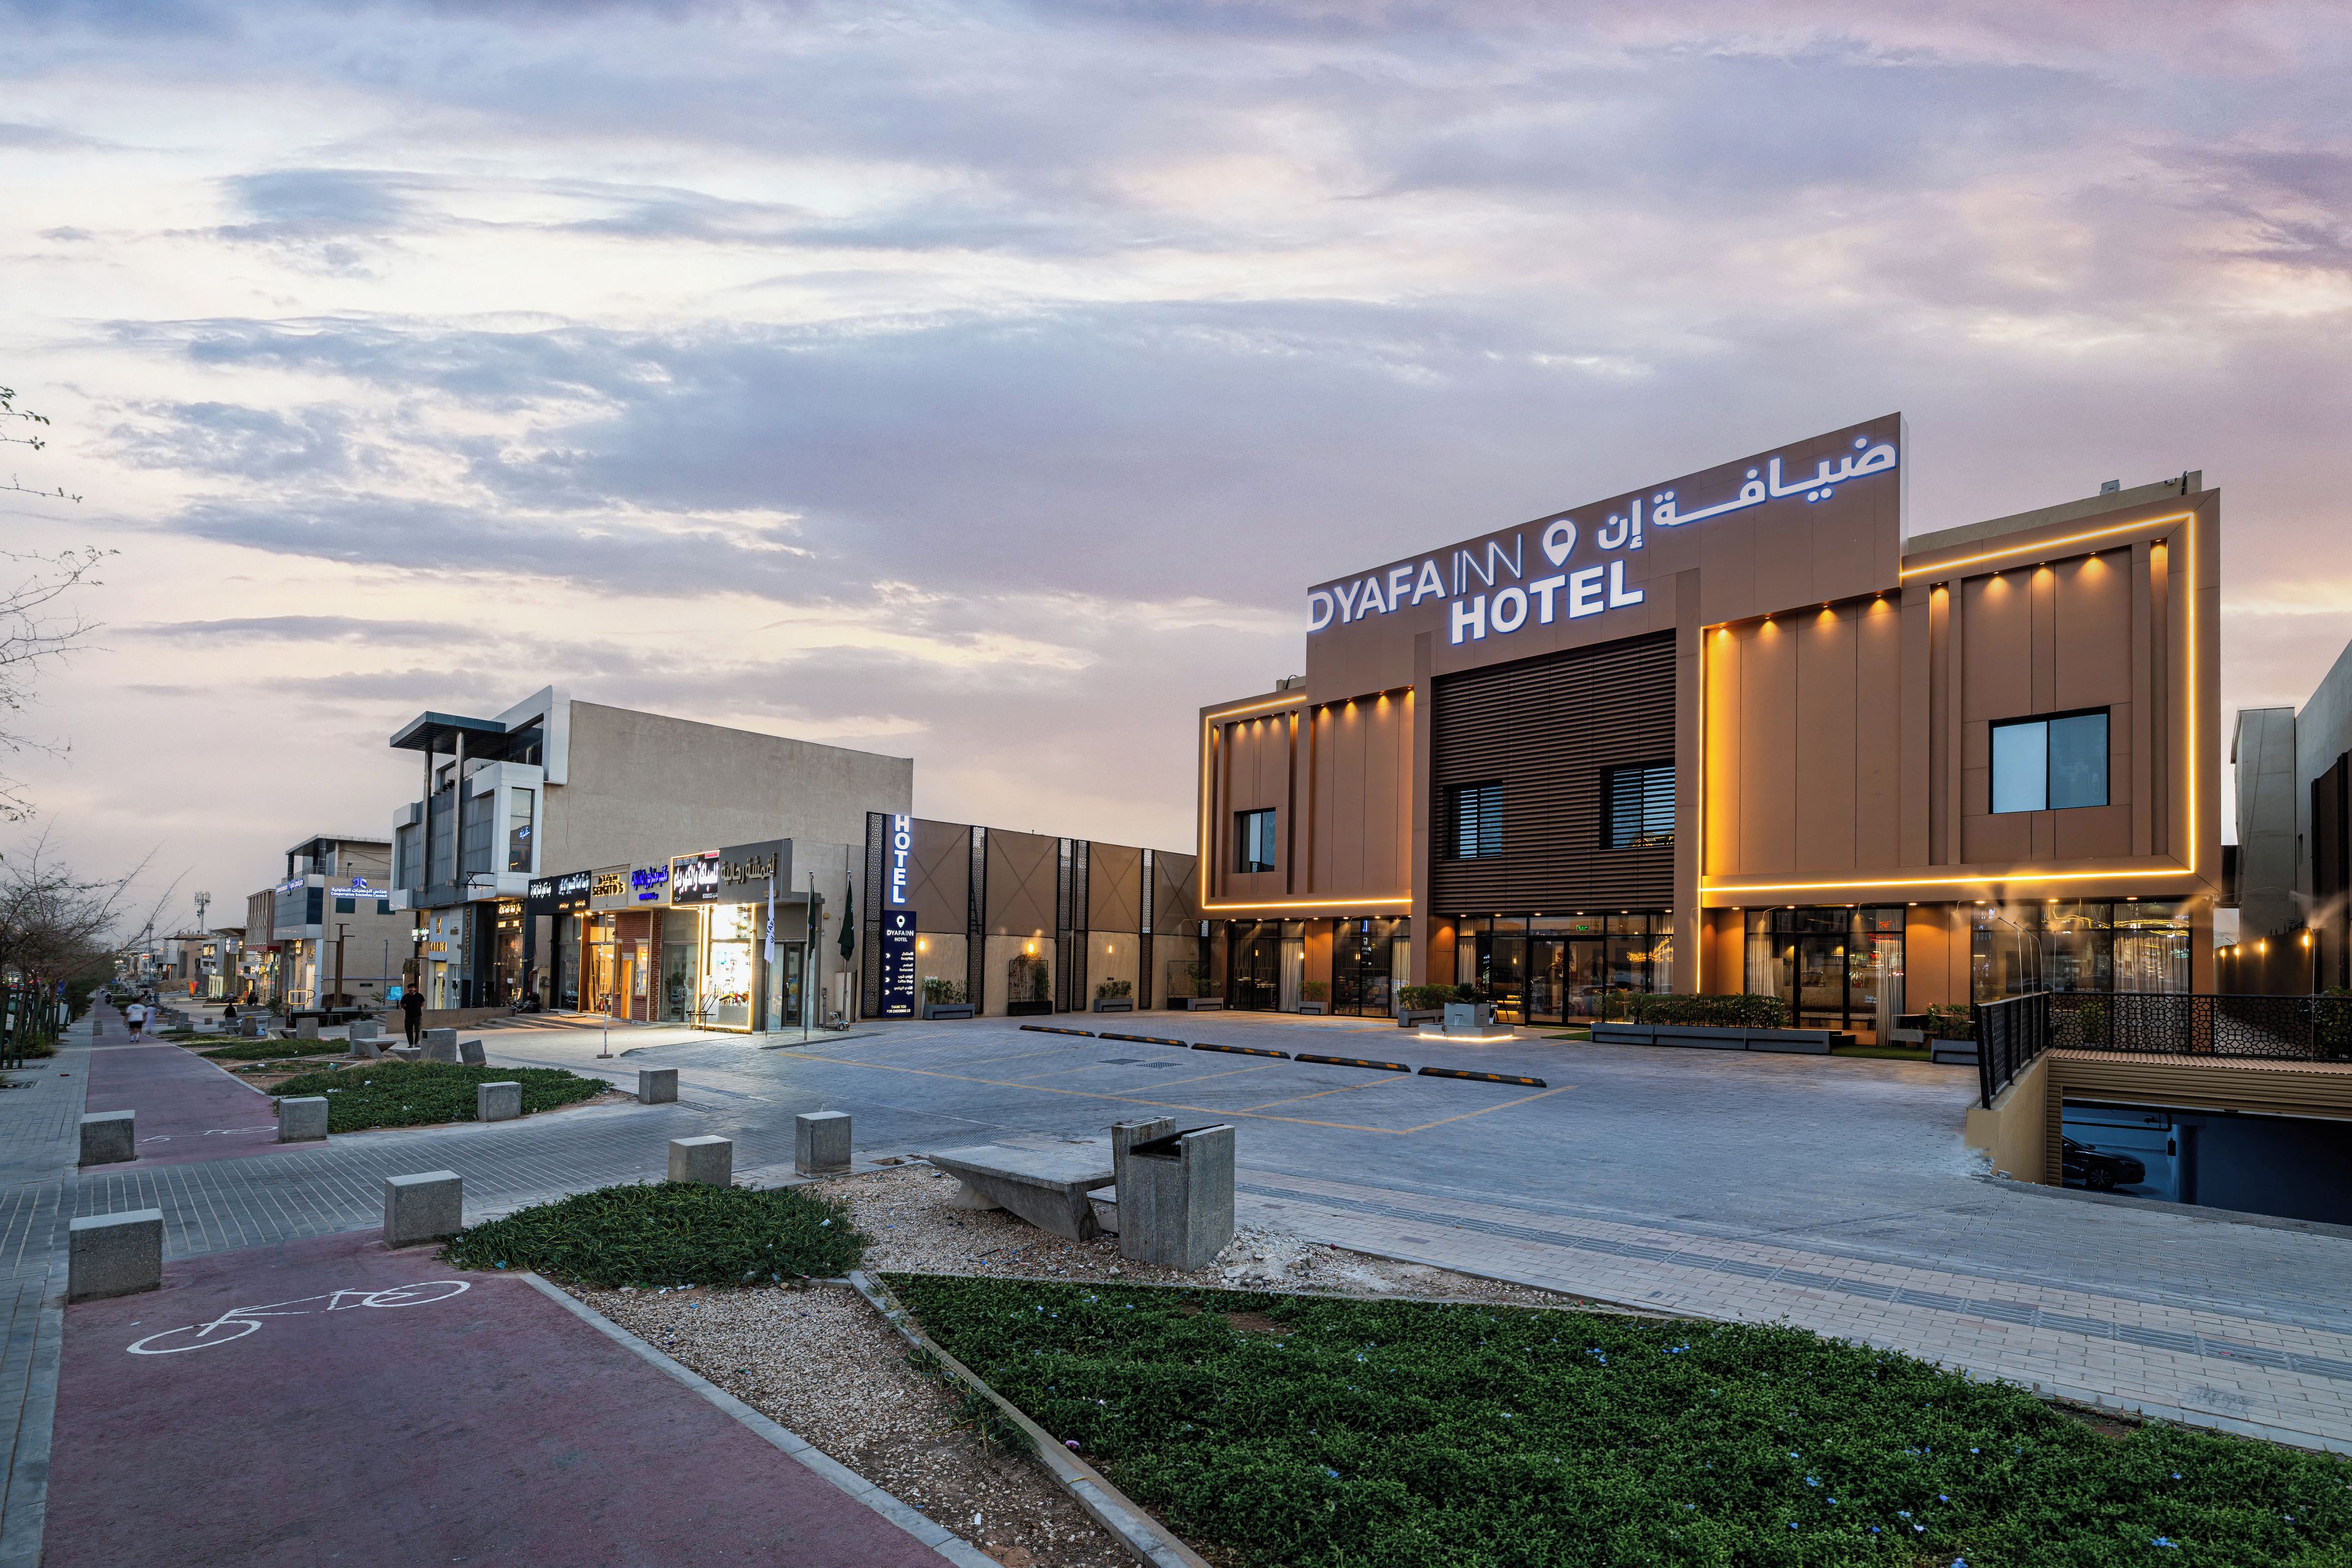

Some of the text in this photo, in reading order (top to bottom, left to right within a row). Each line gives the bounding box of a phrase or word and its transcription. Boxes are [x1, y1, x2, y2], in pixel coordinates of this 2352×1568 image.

[1597, 435, 1898, 551] ضيافة إن
[1306, 532, 1523, 633] DYAFA INN
[1450, 559, 1645, 646] HOTEL
[721, 852, 777, 886] أقمشة رجالية
[892, 814, 911, 903] HOTEL
